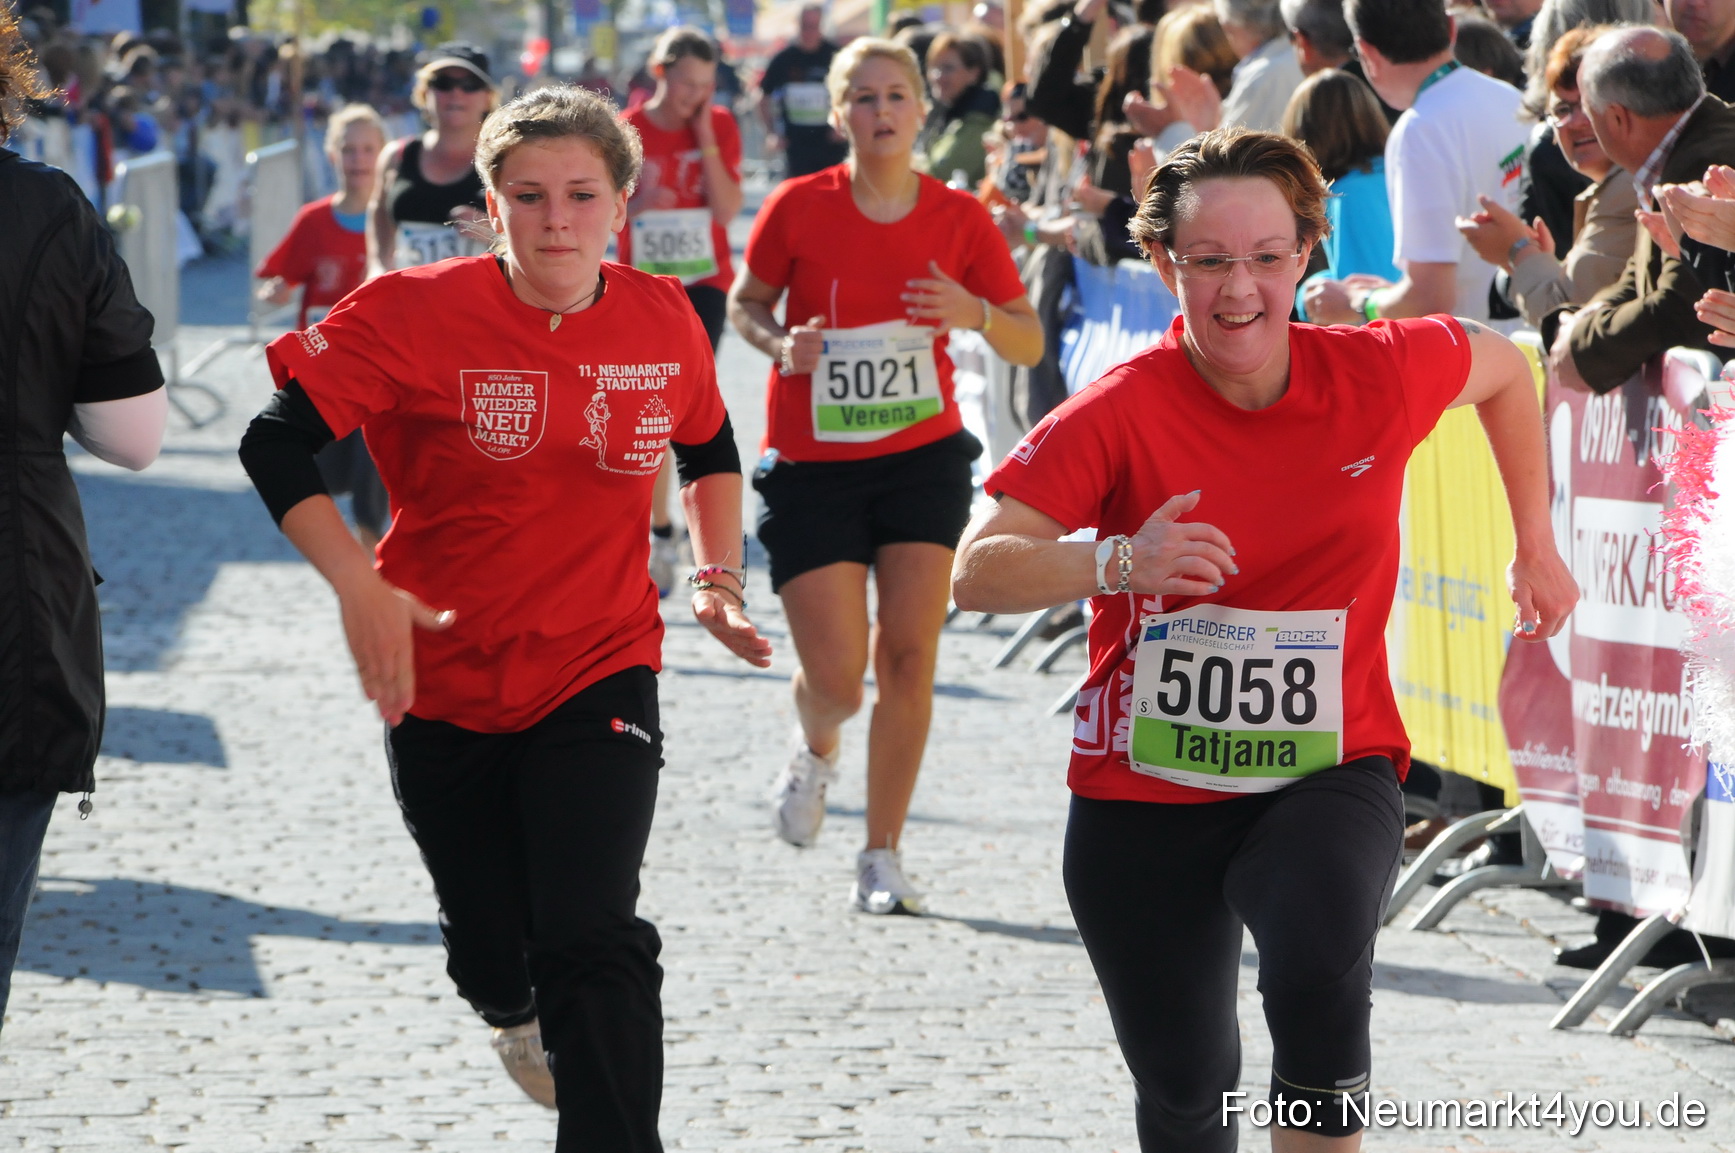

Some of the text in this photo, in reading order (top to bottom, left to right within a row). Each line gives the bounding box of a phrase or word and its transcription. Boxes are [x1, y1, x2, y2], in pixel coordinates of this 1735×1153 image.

[578, 363, 681, 377] 11. NEUMARKTER
[829, 356, 919, 399] 5021
[474, 383, 535, 397] IMMER
[596, 377, 668, 390] STADTLAUF
[472, 398, 537, 412] WIEDER
[475, 411, 532, 433] NEU
[841, 405, 916, 426] Verena
[474, 428, 530, 448] MARKT
[1171, 618, 1328, 643] PFLEIDERER BOCK
[1170, 633, 1255, 651] AKTIENGESELLSCHAFT
[1157, 648, 1318, 726] 5058
[1170, 723, 1298, 774] Tatjana
